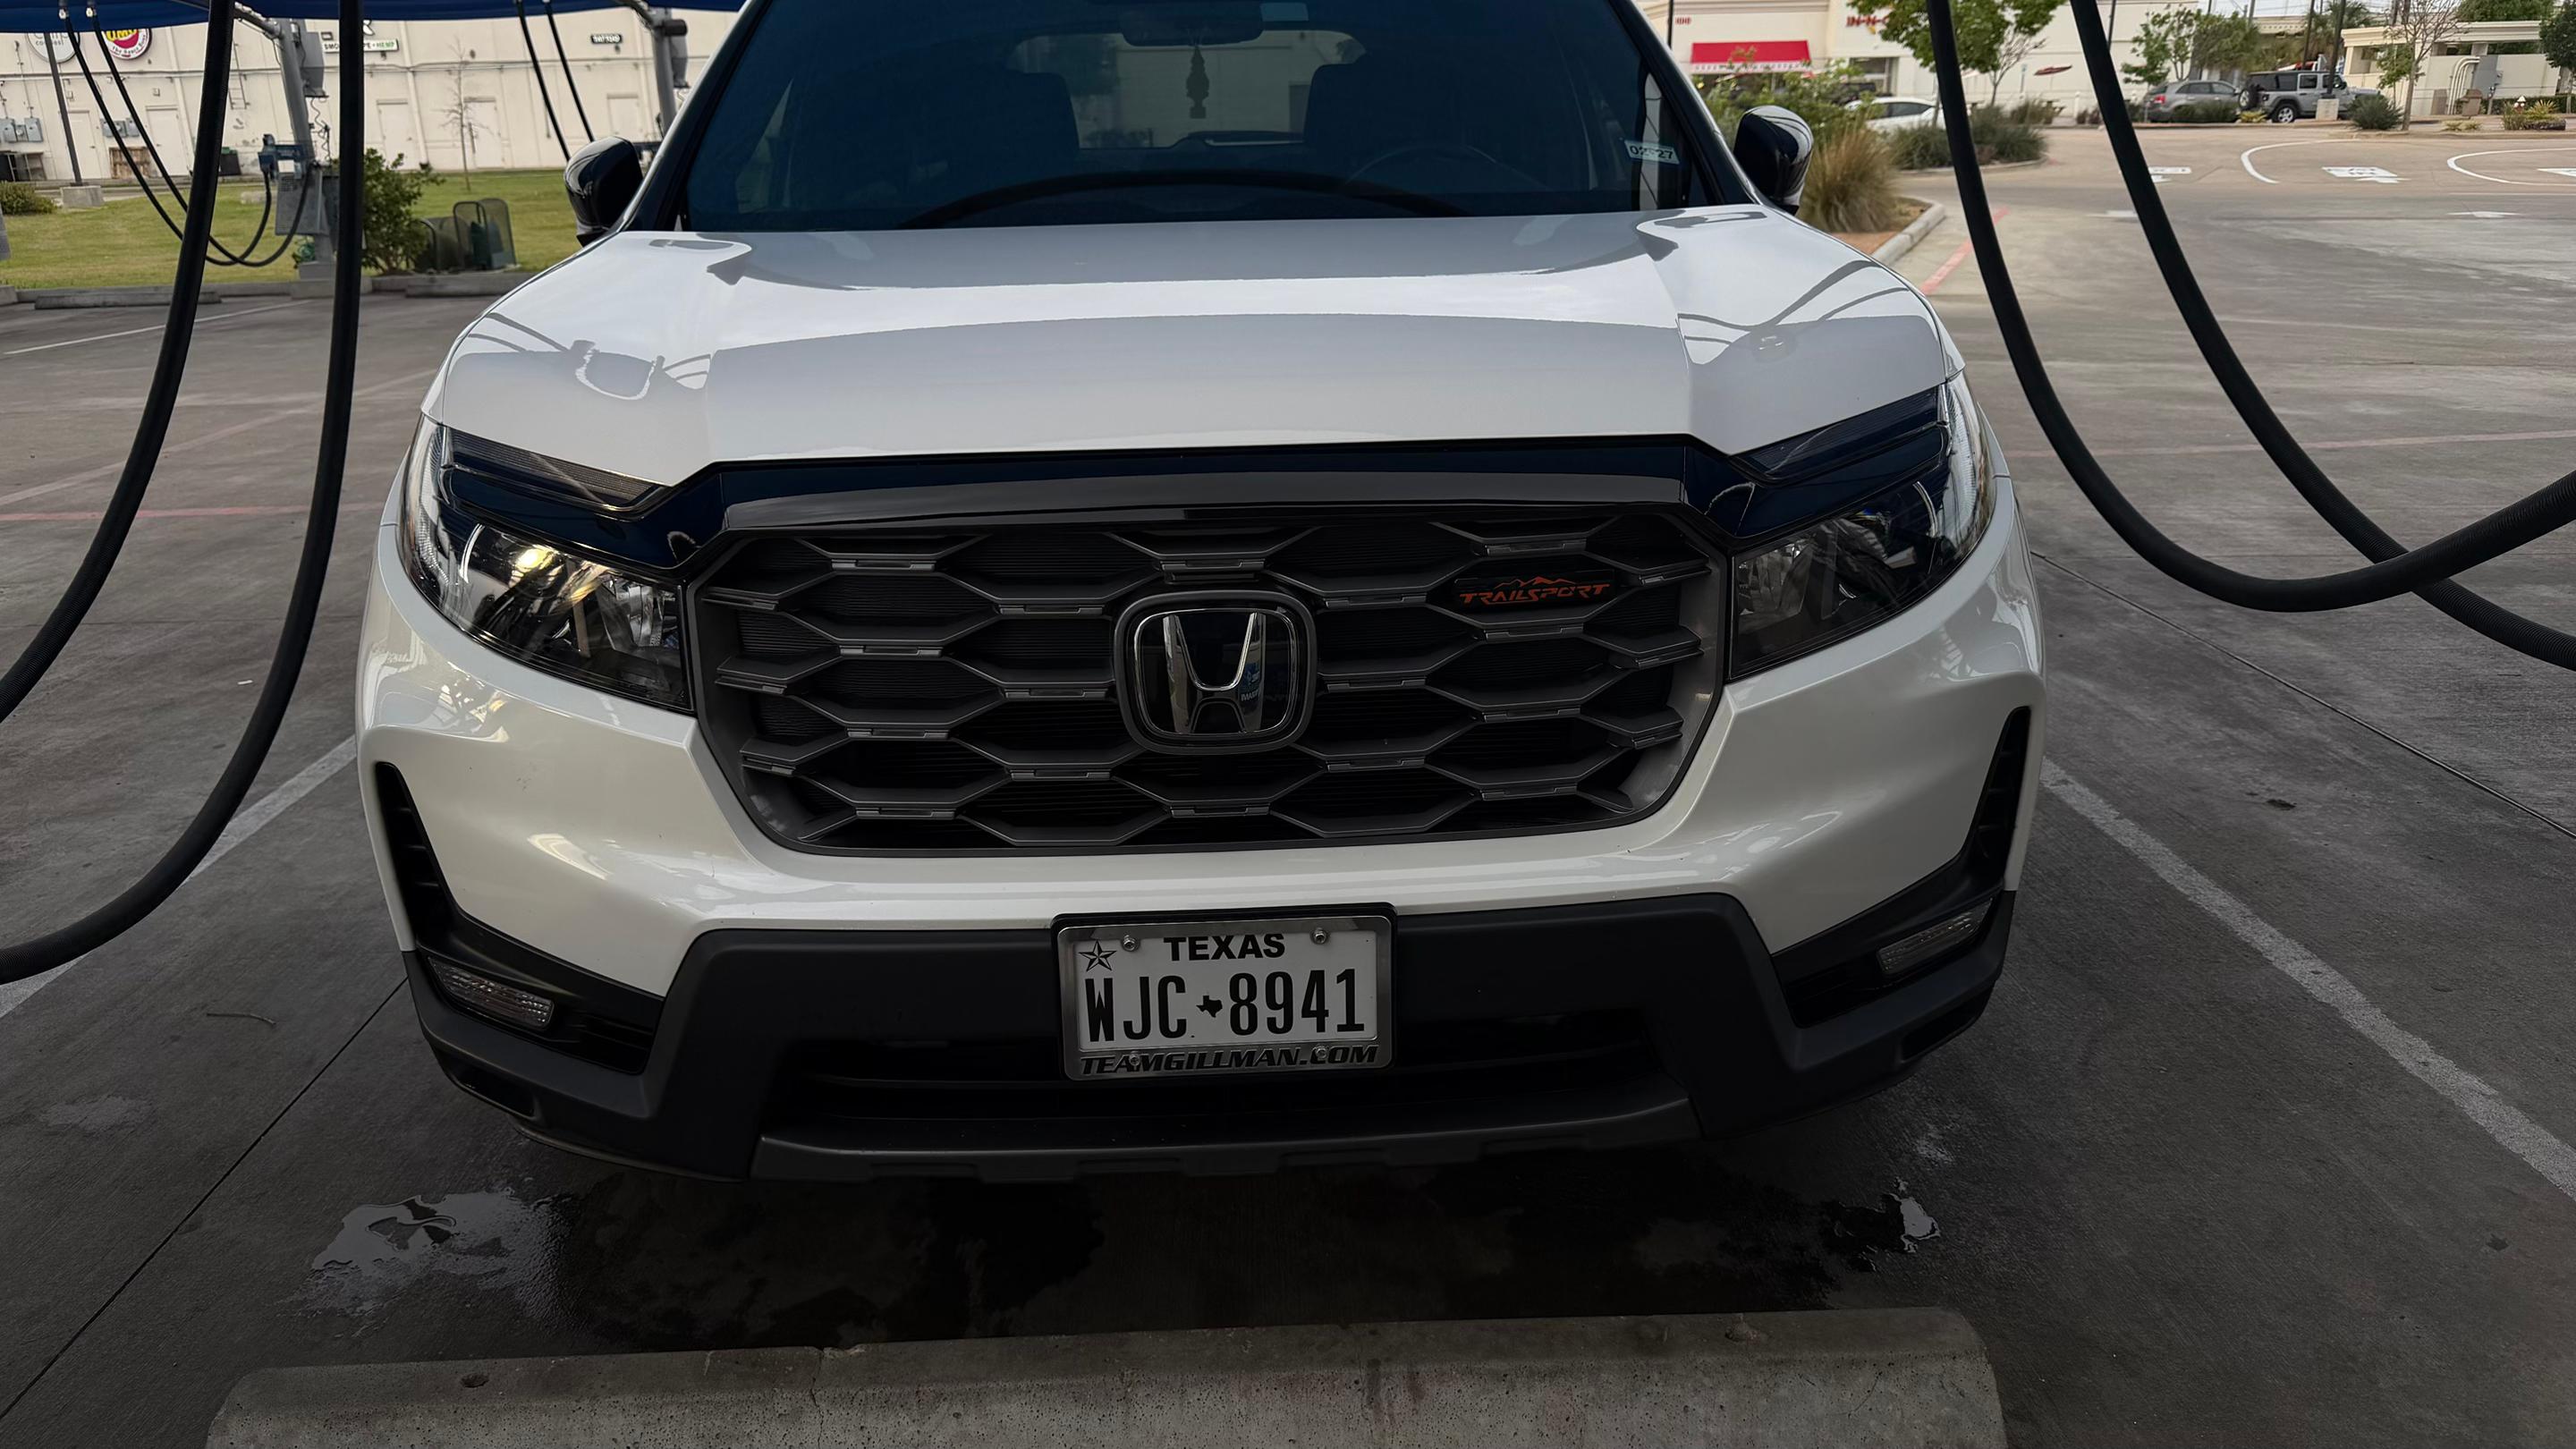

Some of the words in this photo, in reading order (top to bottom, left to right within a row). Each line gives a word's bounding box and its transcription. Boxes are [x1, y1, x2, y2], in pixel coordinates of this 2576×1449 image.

[1459, 583, 1610, 605] TRAILSPORT
[1163, 933, 1286, 962] TEXAS
[1080, 1044, 1381, 1075] TEAMGILLMAN.COM
